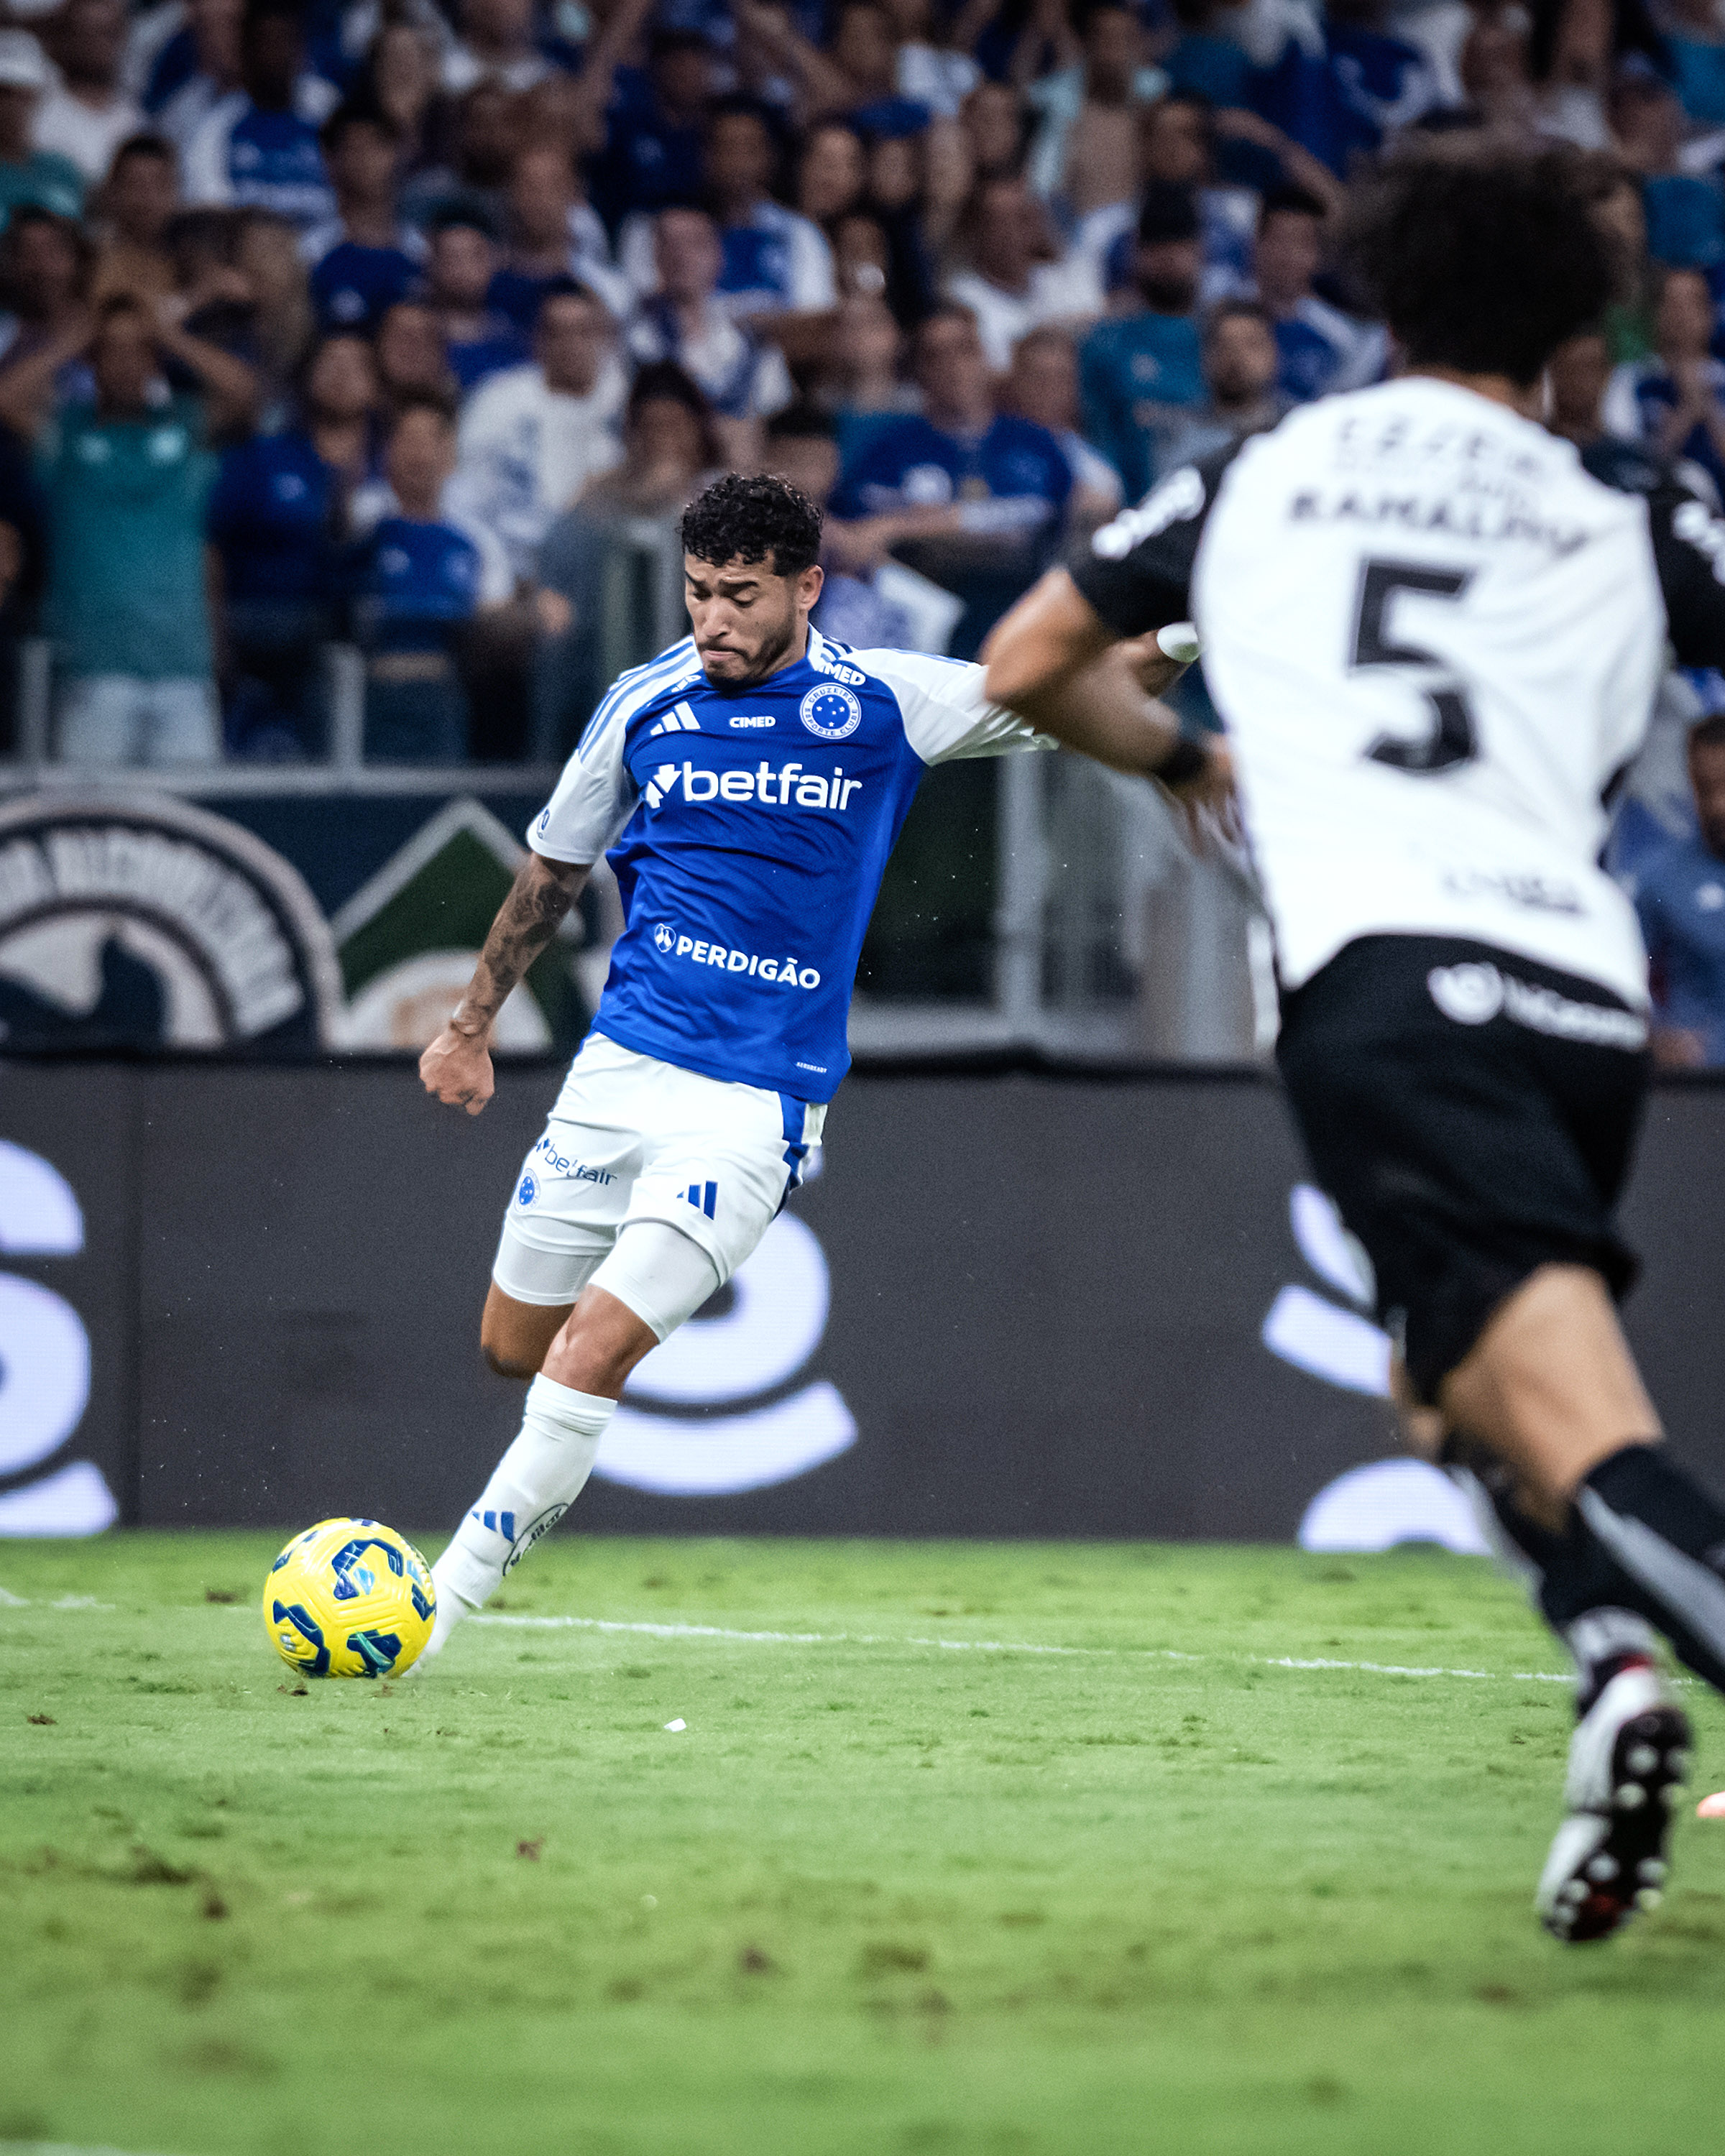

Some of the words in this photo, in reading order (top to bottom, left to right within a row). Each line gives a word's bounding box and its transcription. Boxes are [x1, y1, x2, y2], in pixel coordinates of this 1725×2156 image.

[814, 662, 866, 686] IMED
[1348, 553, 1482, 773] 5
[808, 687, 854, 703] CRUZEIRO
[730, 716, 776, 728] CIMED
[683, 761, 862, 810] betfair
[676, 935, 821, 990] PERDIGÃO
